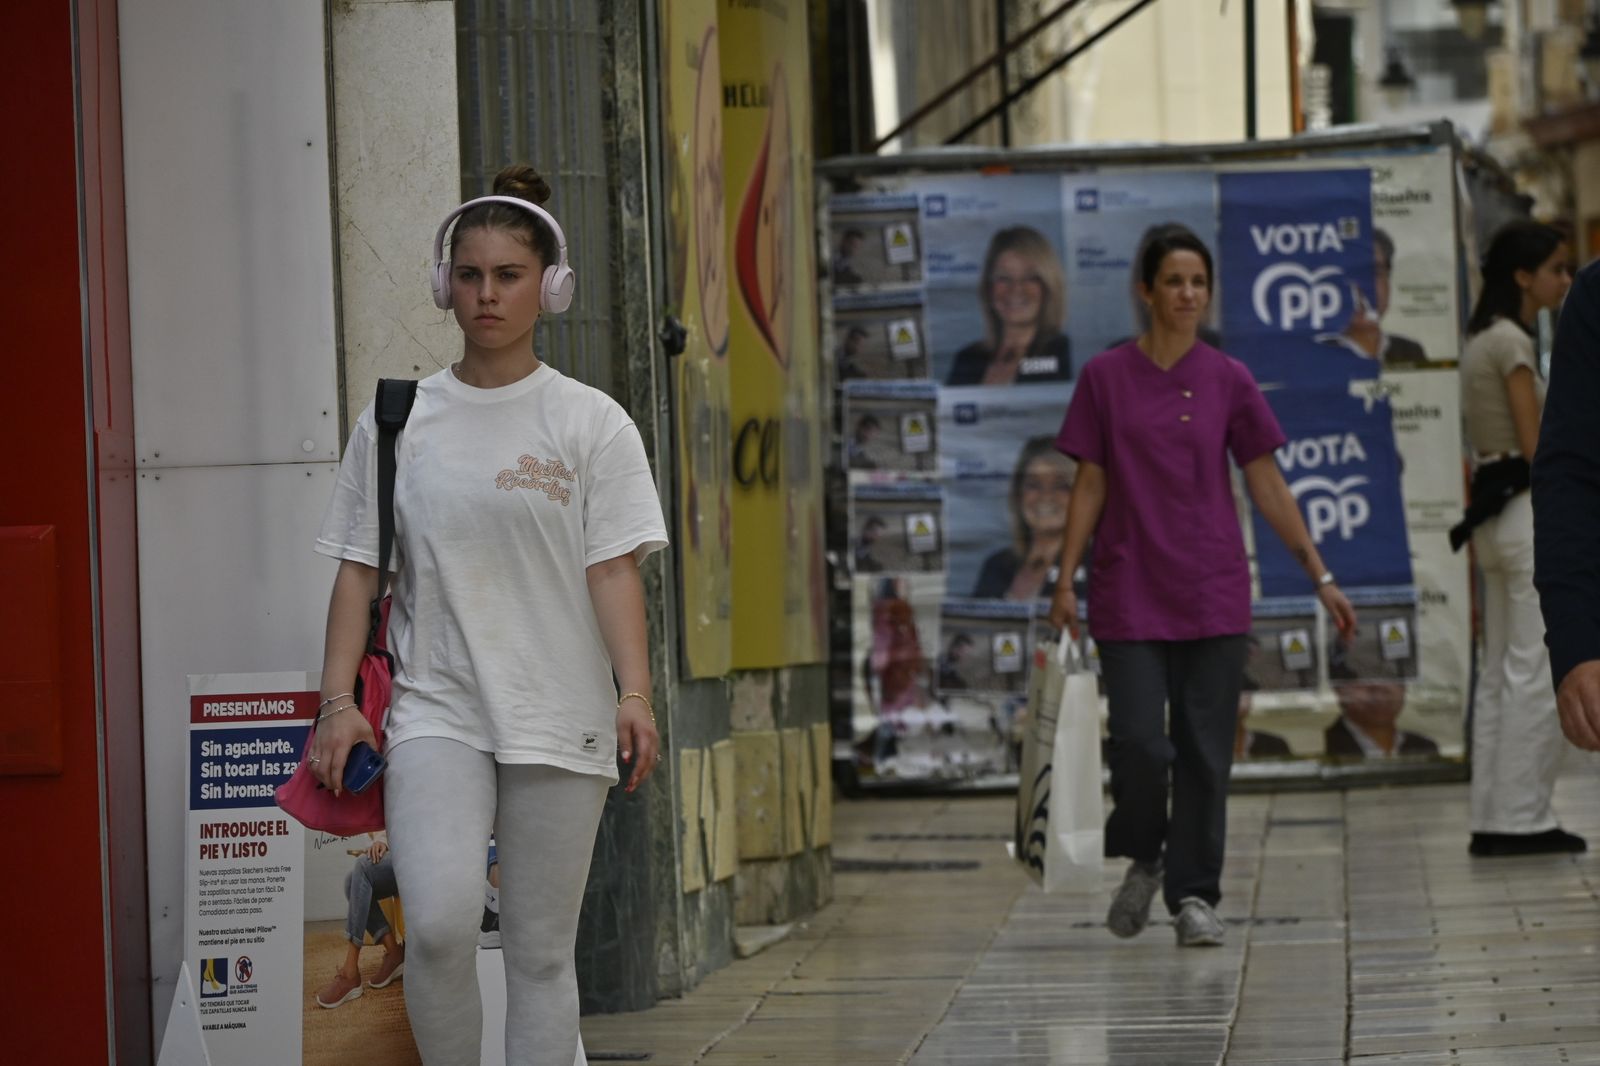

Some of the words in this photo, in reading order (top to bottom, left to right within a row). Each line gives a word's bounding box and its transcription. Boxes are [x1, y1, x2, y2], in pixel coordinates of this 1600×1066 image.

[1251, 223, 1343, 254] VOTA
[1274, 433, 1367, 471] VOTA
[203, 699, 294, 717] PRESENTAMOS
[201, 741, 222, 756] Sin
[225, 739, 294, 759] agacharte.
[201, 762, 222, 778] Sin
[225, 761, 258, 777] tocar
[262, 759, 279, 775] las
[283, 761, 300, 775] za
[201, 784, 222, 799] Sin
[200, 822, 273, 839] INTRODUCE
[276, 820, 289, 836] EL
[200, 845, 219, 860] PIE
[222, 844, 230, 859] Y
[233, 841, 267, 857] LISTO
[199, 938, 224, 946] mantiene
[230, 937, 238, 946] pie
